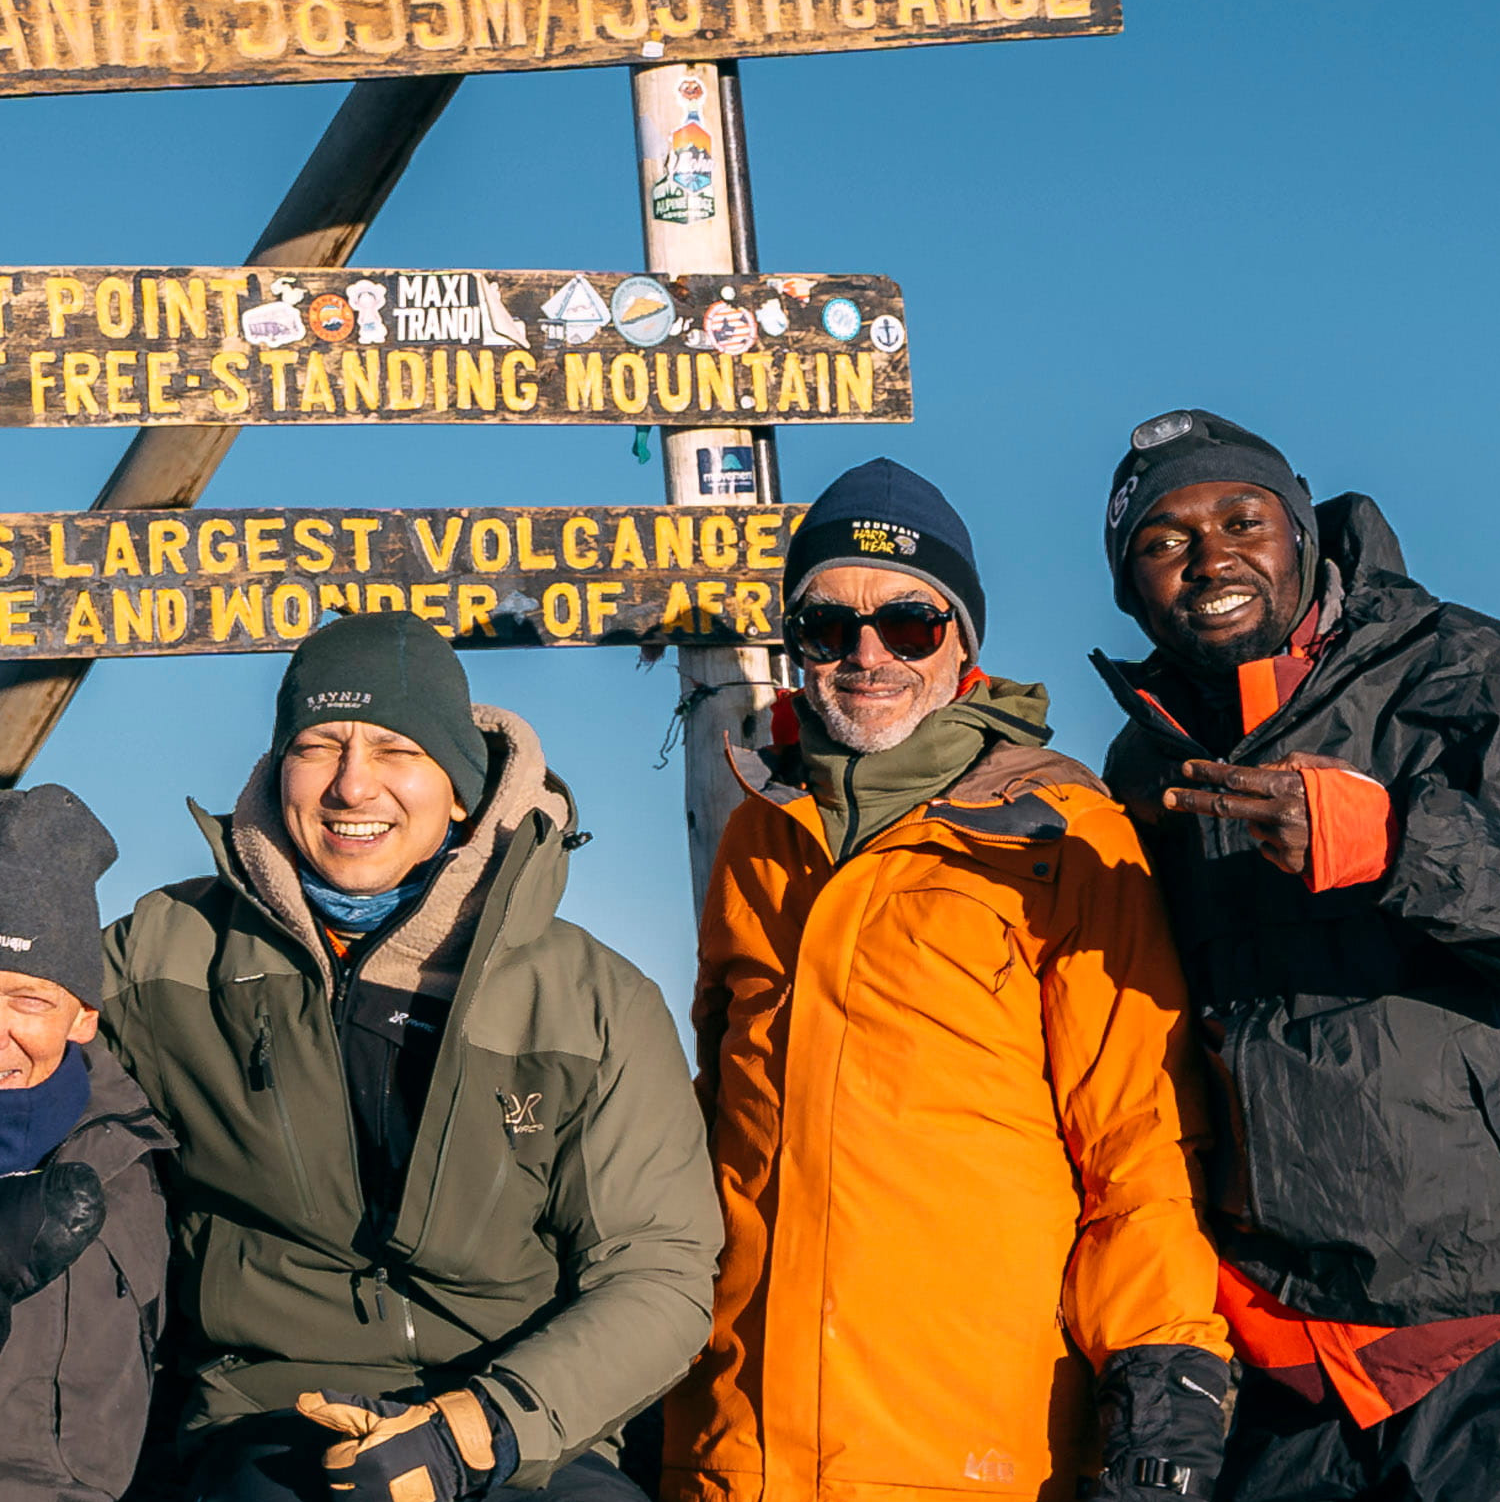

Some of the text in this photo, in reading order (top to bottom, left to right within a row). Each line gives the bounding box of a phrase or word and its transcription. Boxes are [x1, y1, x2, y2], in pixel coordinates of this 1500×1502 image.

[46, 276, 247, 340] POINT
[399, 274, 468, 307] MAXI
[565, 349, 874, 415] MOUNTAIN
[49, 515, 382, 580] LARGEST
[413, 513, 806, 573] VOLCANOE
[852, 520, 921, 540] MOUNTAIN
[852, 529, 888, 542] HARD
[860, 539, 896, 555] WEAR
[65, 588, 188, 646] AND
[543, 582, 625, 638] OF
